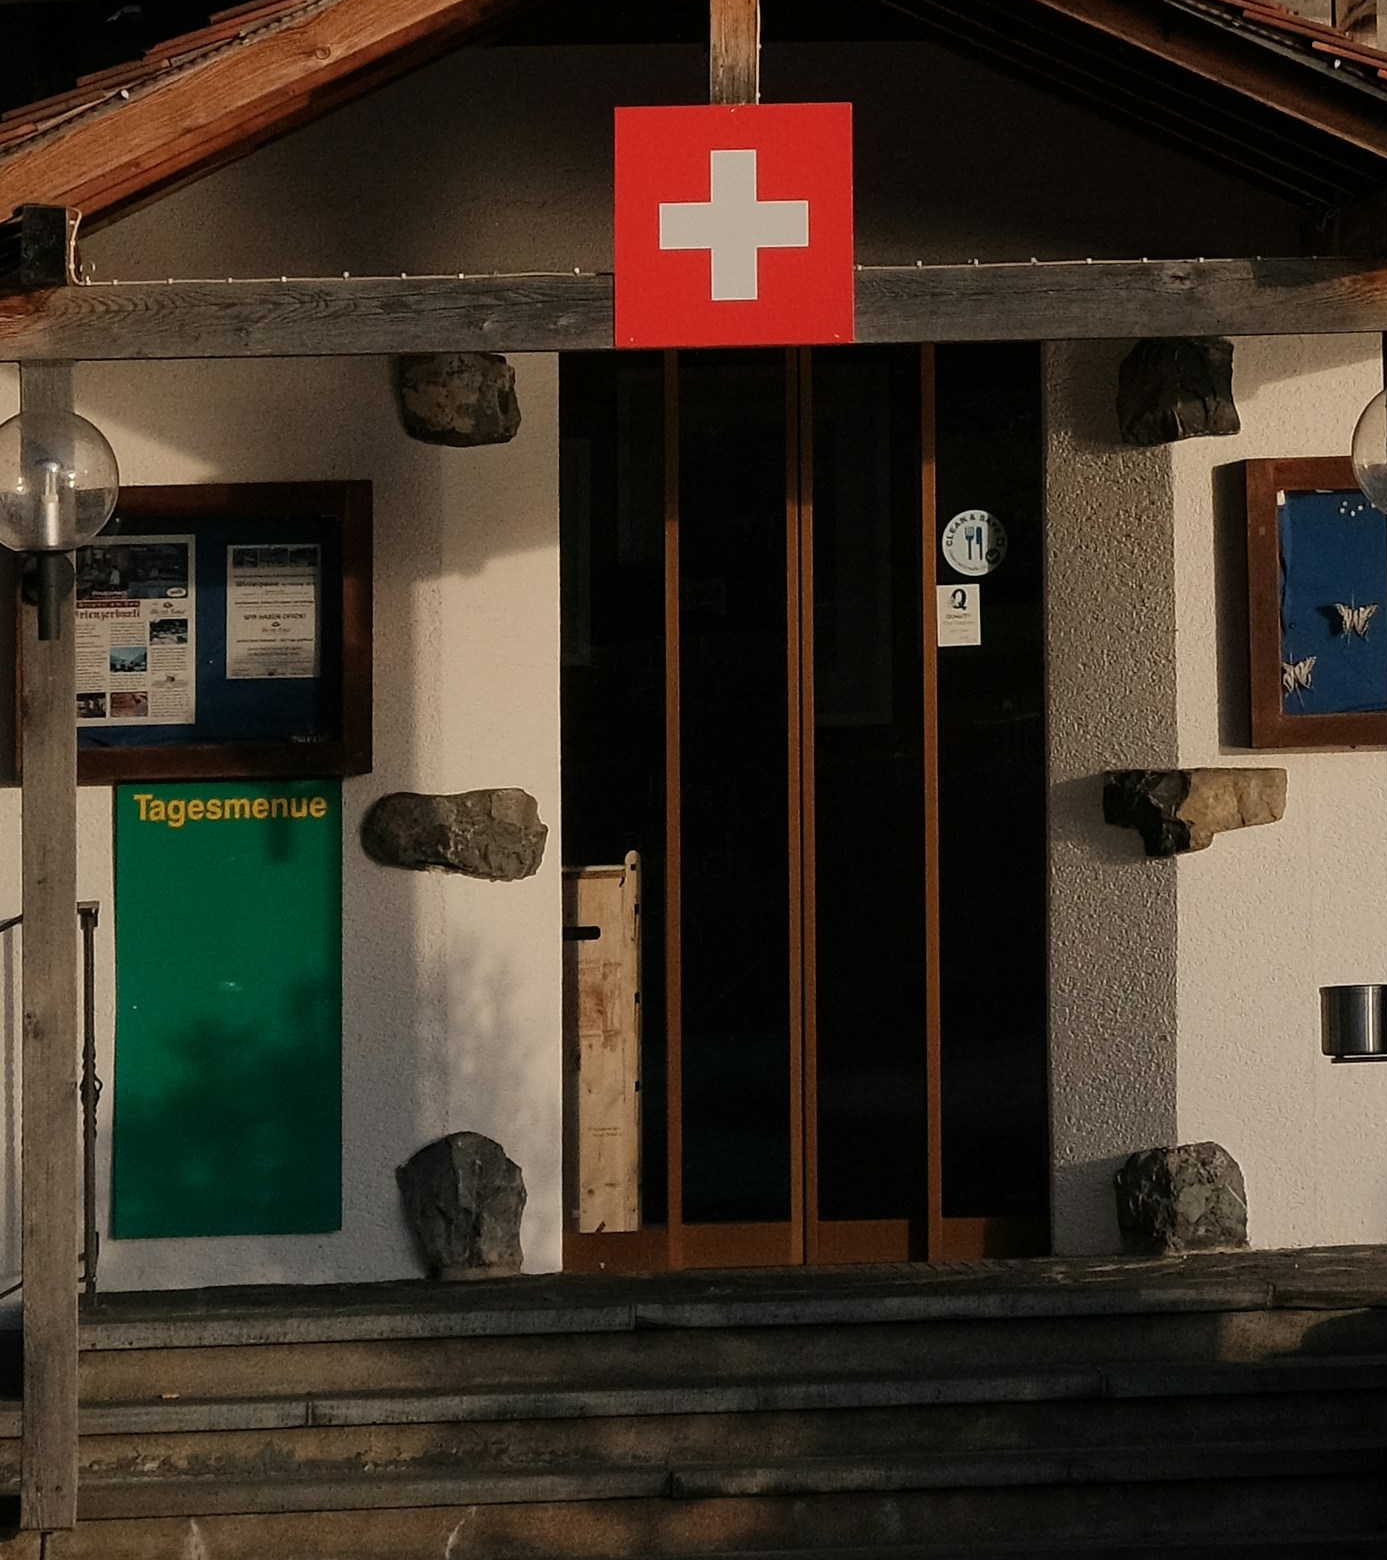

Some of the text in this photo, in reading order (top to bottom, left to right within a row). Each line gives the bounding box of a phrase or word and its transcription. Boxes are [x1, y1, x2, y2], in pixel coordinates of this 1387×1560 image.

[945, 516, 968, 547] CLEAN
[969, 513, 976, 521] &
[133, 793, 328, 828] Tagesmenue
